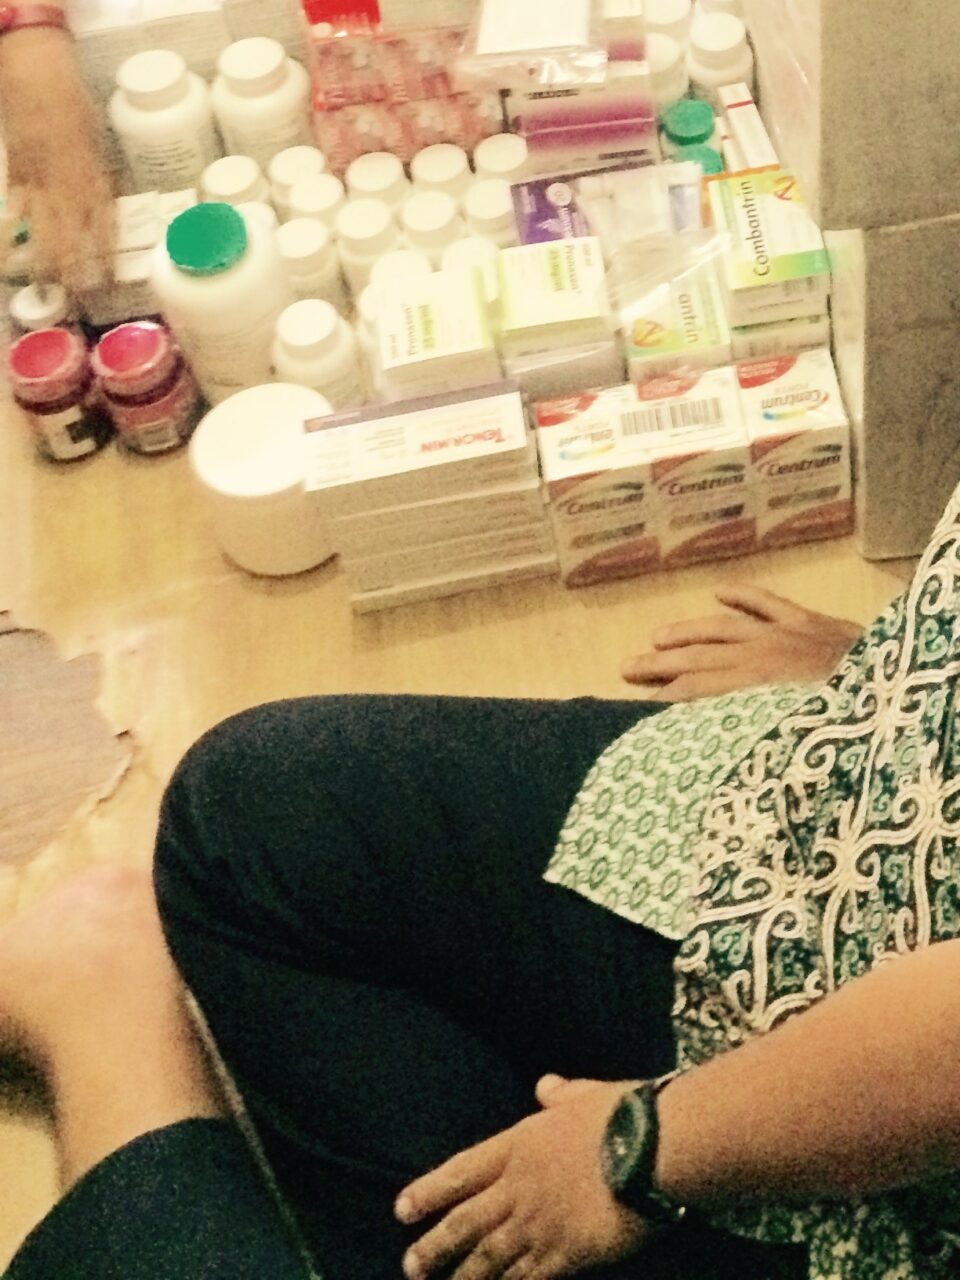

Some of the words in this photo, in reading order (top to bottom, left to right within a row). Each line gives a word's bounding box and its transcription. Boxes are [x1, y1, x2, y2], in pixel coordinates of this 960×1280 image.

[738, 180, 770, 277] Combantrin
[761, 388, 823, 409] Centrum
[766, 453, 841, 477] Centrum
[668, 473, 746, 496] Centrum
[567, 492, 645, 516] Centrum
